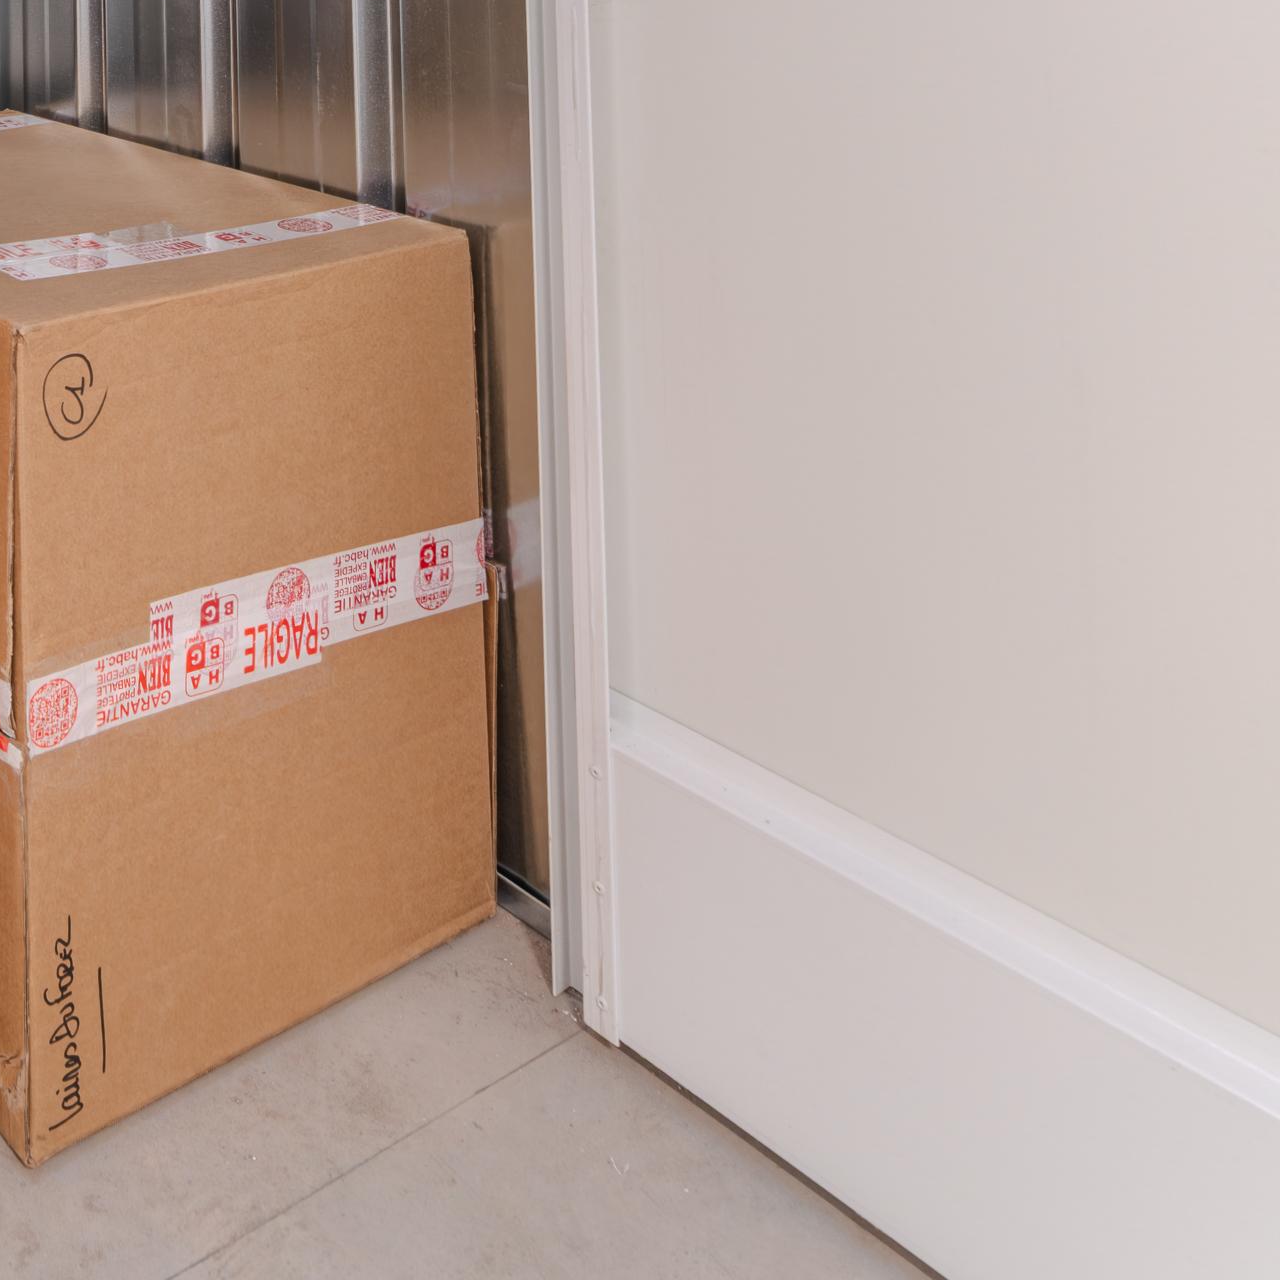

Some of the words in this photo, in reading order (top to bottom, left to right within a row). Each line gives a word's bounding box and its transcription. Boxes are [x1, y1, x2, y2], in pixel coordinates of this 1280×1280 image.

[332, 541, 396, 567] www.habc.fr
[334, 561, 368, 578] EXPEDIE
[334, 572, 368, 588] EMBALLE
[369, 553, 397, 589] BIEN
[334, 582, 368, 599] PROTEGE
[242, 608, 324, 674] RAGILE
[94, 639, 172, 673] www.habc.fr
[96, 664, 137, 685] EXPEDIE
[138, 651, 172, 693] BIEN
[96, 676, 137, 698] EMBALLE
[96, 687, 137, 709] PROTEGE
[95, 688, 172, 728] GARANTIE
